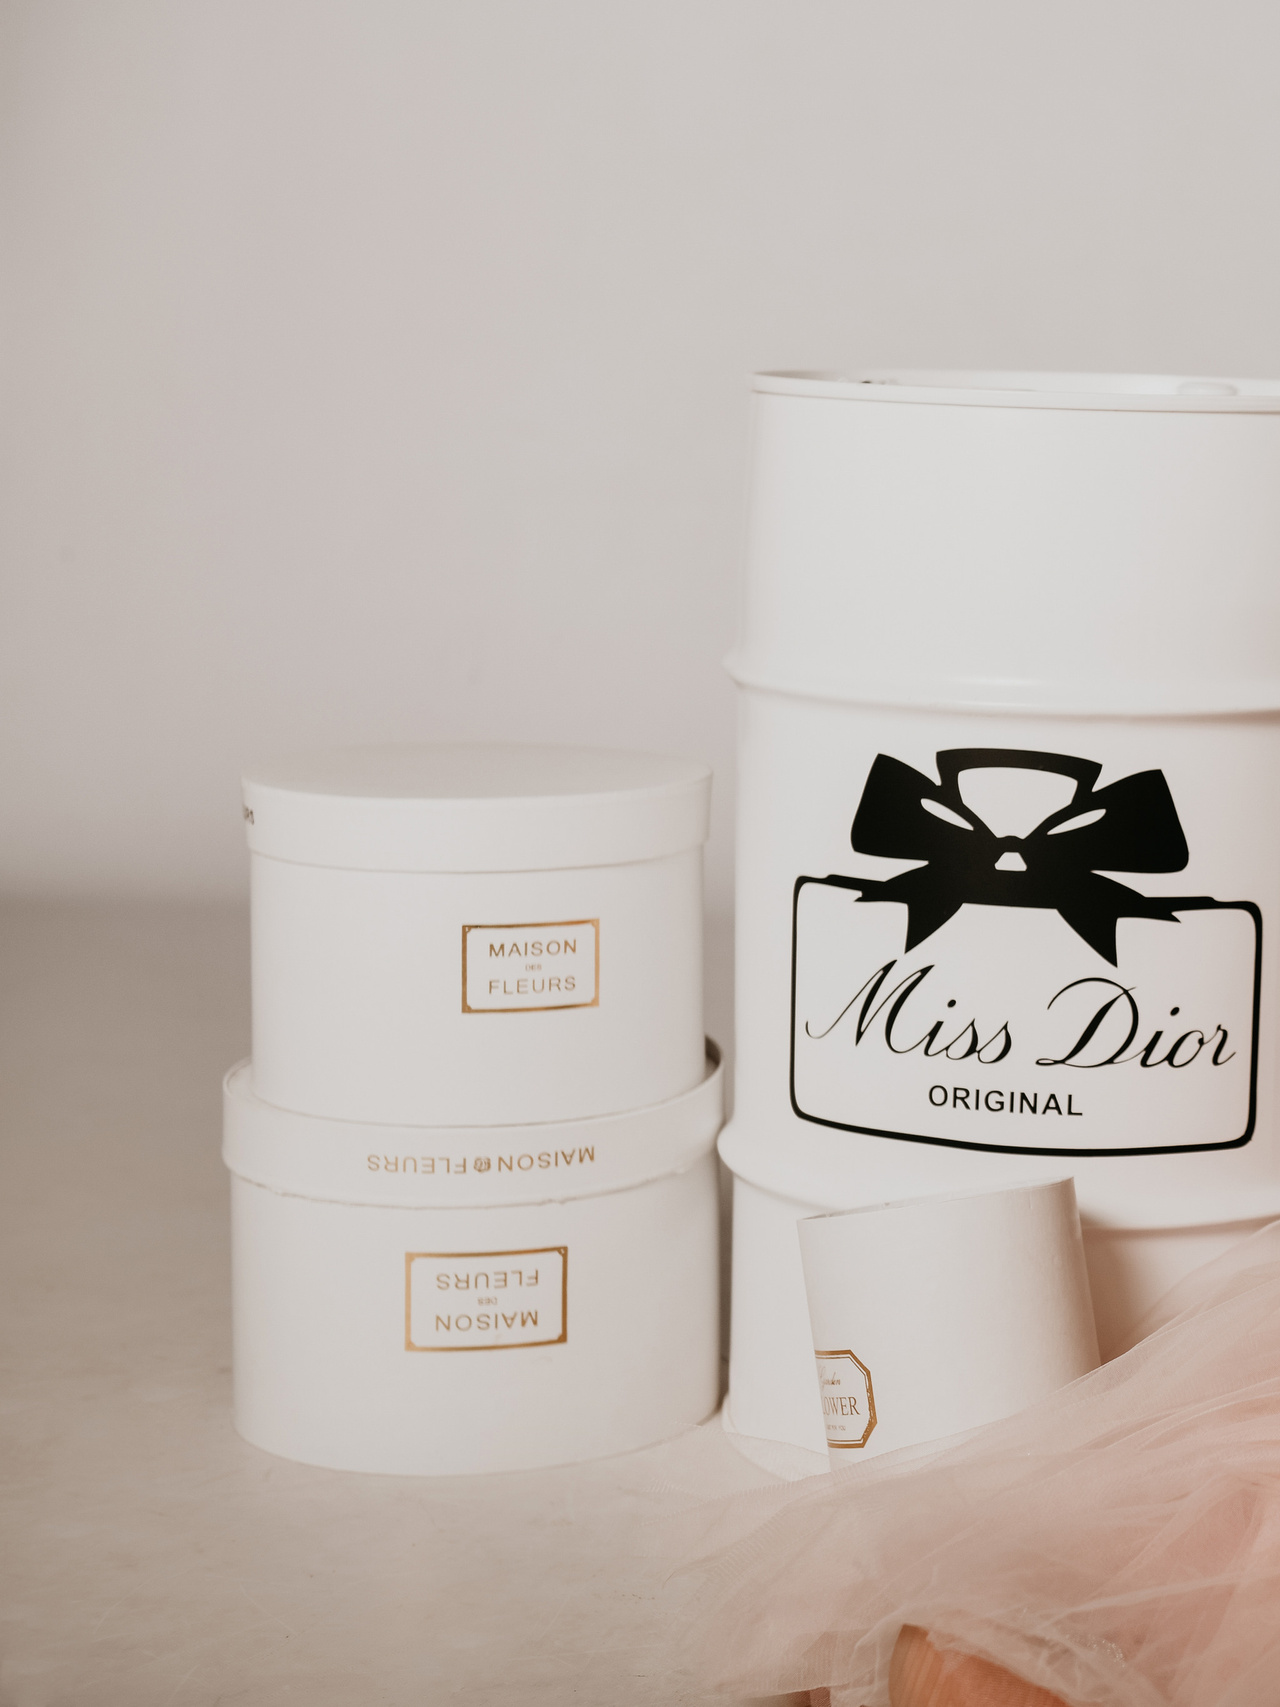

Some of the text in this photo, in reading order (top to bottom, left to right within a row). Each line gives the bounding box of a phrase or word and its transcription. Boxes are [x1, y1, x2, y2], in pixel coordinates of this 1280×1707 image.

[488, 938, 577, 958] MAISON
[488, 975, 576, 995] FLEURS
[805, 958, 1238, 1069] Miss Dior
[927, 1084, 1084, 1117] ORIGINAL
[367, 1145, 596, 1175] MAISON FLEURS
[436, 1268, 539, 1291] FLEURS
[435, 1309, 539, 1332] MAISON
